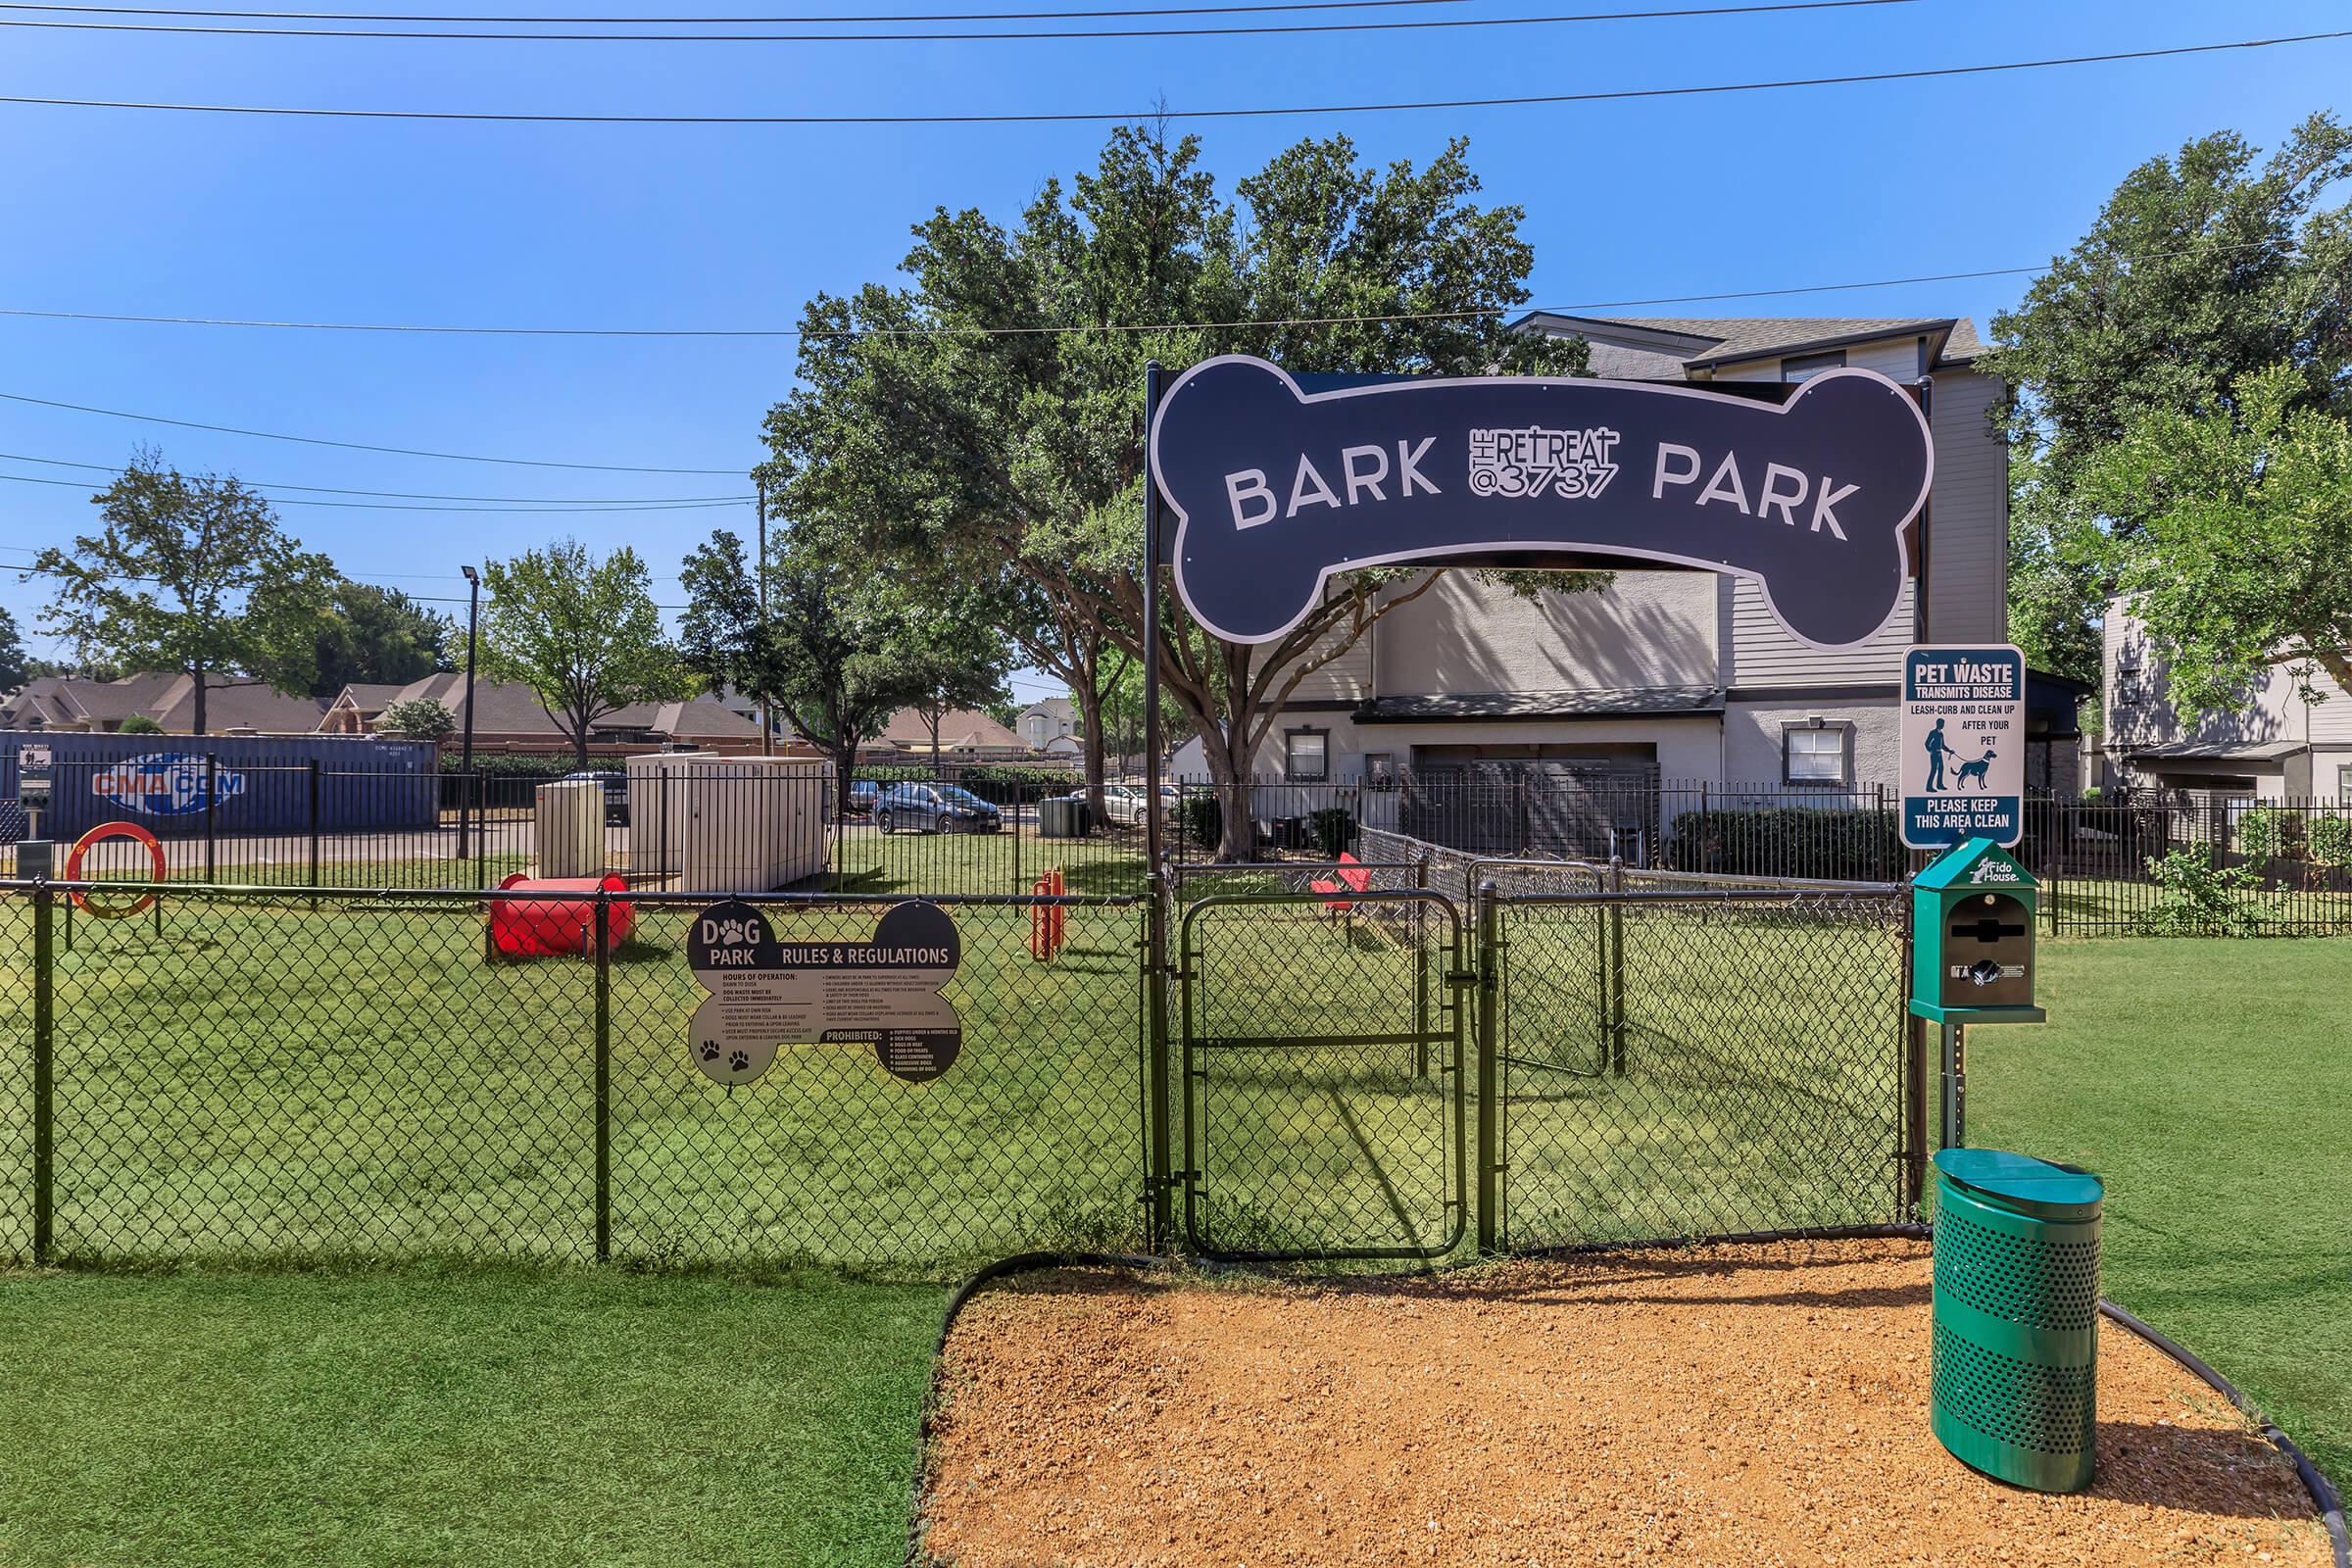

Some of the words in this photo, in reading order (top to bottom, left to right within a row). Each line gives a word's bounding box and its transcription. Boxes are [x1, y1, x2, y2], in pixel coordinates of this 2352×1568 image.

[1472, 432, 1495, 468] THE
[1496, 429, 1617, 470] RETREAT
[1223, 436, 1442, 531] BARK
[1471, 465, 1616, 495] @3737
[1651, 441, 1861, 542] PARK
[1915, 664, 1948, 683] PET
[1954, 664, 2013, 683] WASTE
[1915, 686, 1970, 699] TRANSMITS
[1973, 686, 2012, 699] DISEASE
[1911, 705, 1958, 715] LEASH-CURB
[1960, 705, 1975, 715] AND
[1978, 705, 2002, 715] CLEAN
[2004, 705, 2015, 715] UP
[1962, 721, 1986, 730] AFTER
[1988, 721, 2009, 730] YOUR
[1980, 736, 1997, 745] PET
[94, 774, 169, 794] CMA
[1927, 799, 1968, 812] PLEASE
[1971, 799, 1998, 812] KEEP
[1915, 814, 1940, 828] THIS
[1943, 814, 1972, 828] AREA
[1975, 814, 2009, 828] CLEAN
[1989, 861, 2012, 872] Fido
[710, 949, 755, 965] PARK
[783, 948, 828, 964] RULES
[832, 948, 843, 964] &
[848, 948, 949, 964] REGULATIONS
[826, 1030, 882, 1041] PROHIBITED:
